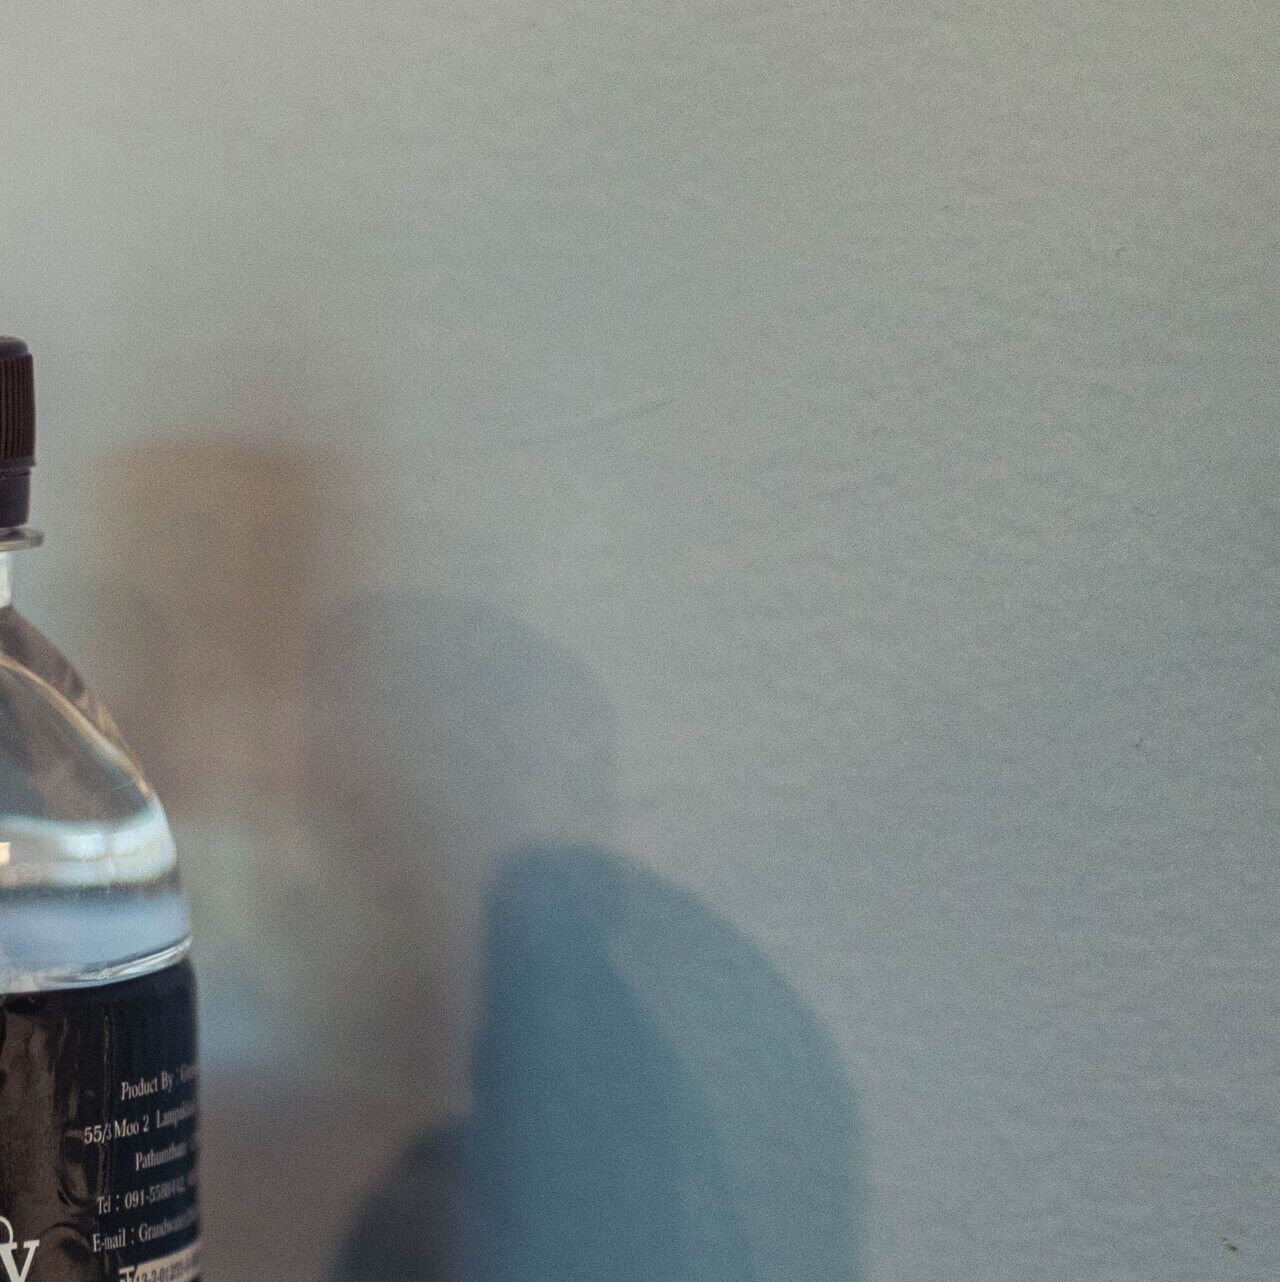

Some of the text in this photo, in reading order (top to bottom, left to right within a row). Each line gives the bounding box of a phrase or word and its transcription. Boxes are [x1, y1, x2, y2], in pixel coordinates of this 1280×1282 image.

[120, 1077, 158, 1101] Product
[161, 1070, 174, 1093] By
[113, 1118, 140, 1139] Moo
[142, 1114, 151, 1134] 2
[96, 1195, 111, 1215] Tel
[92, 1228, 127, 1253] E-mail
